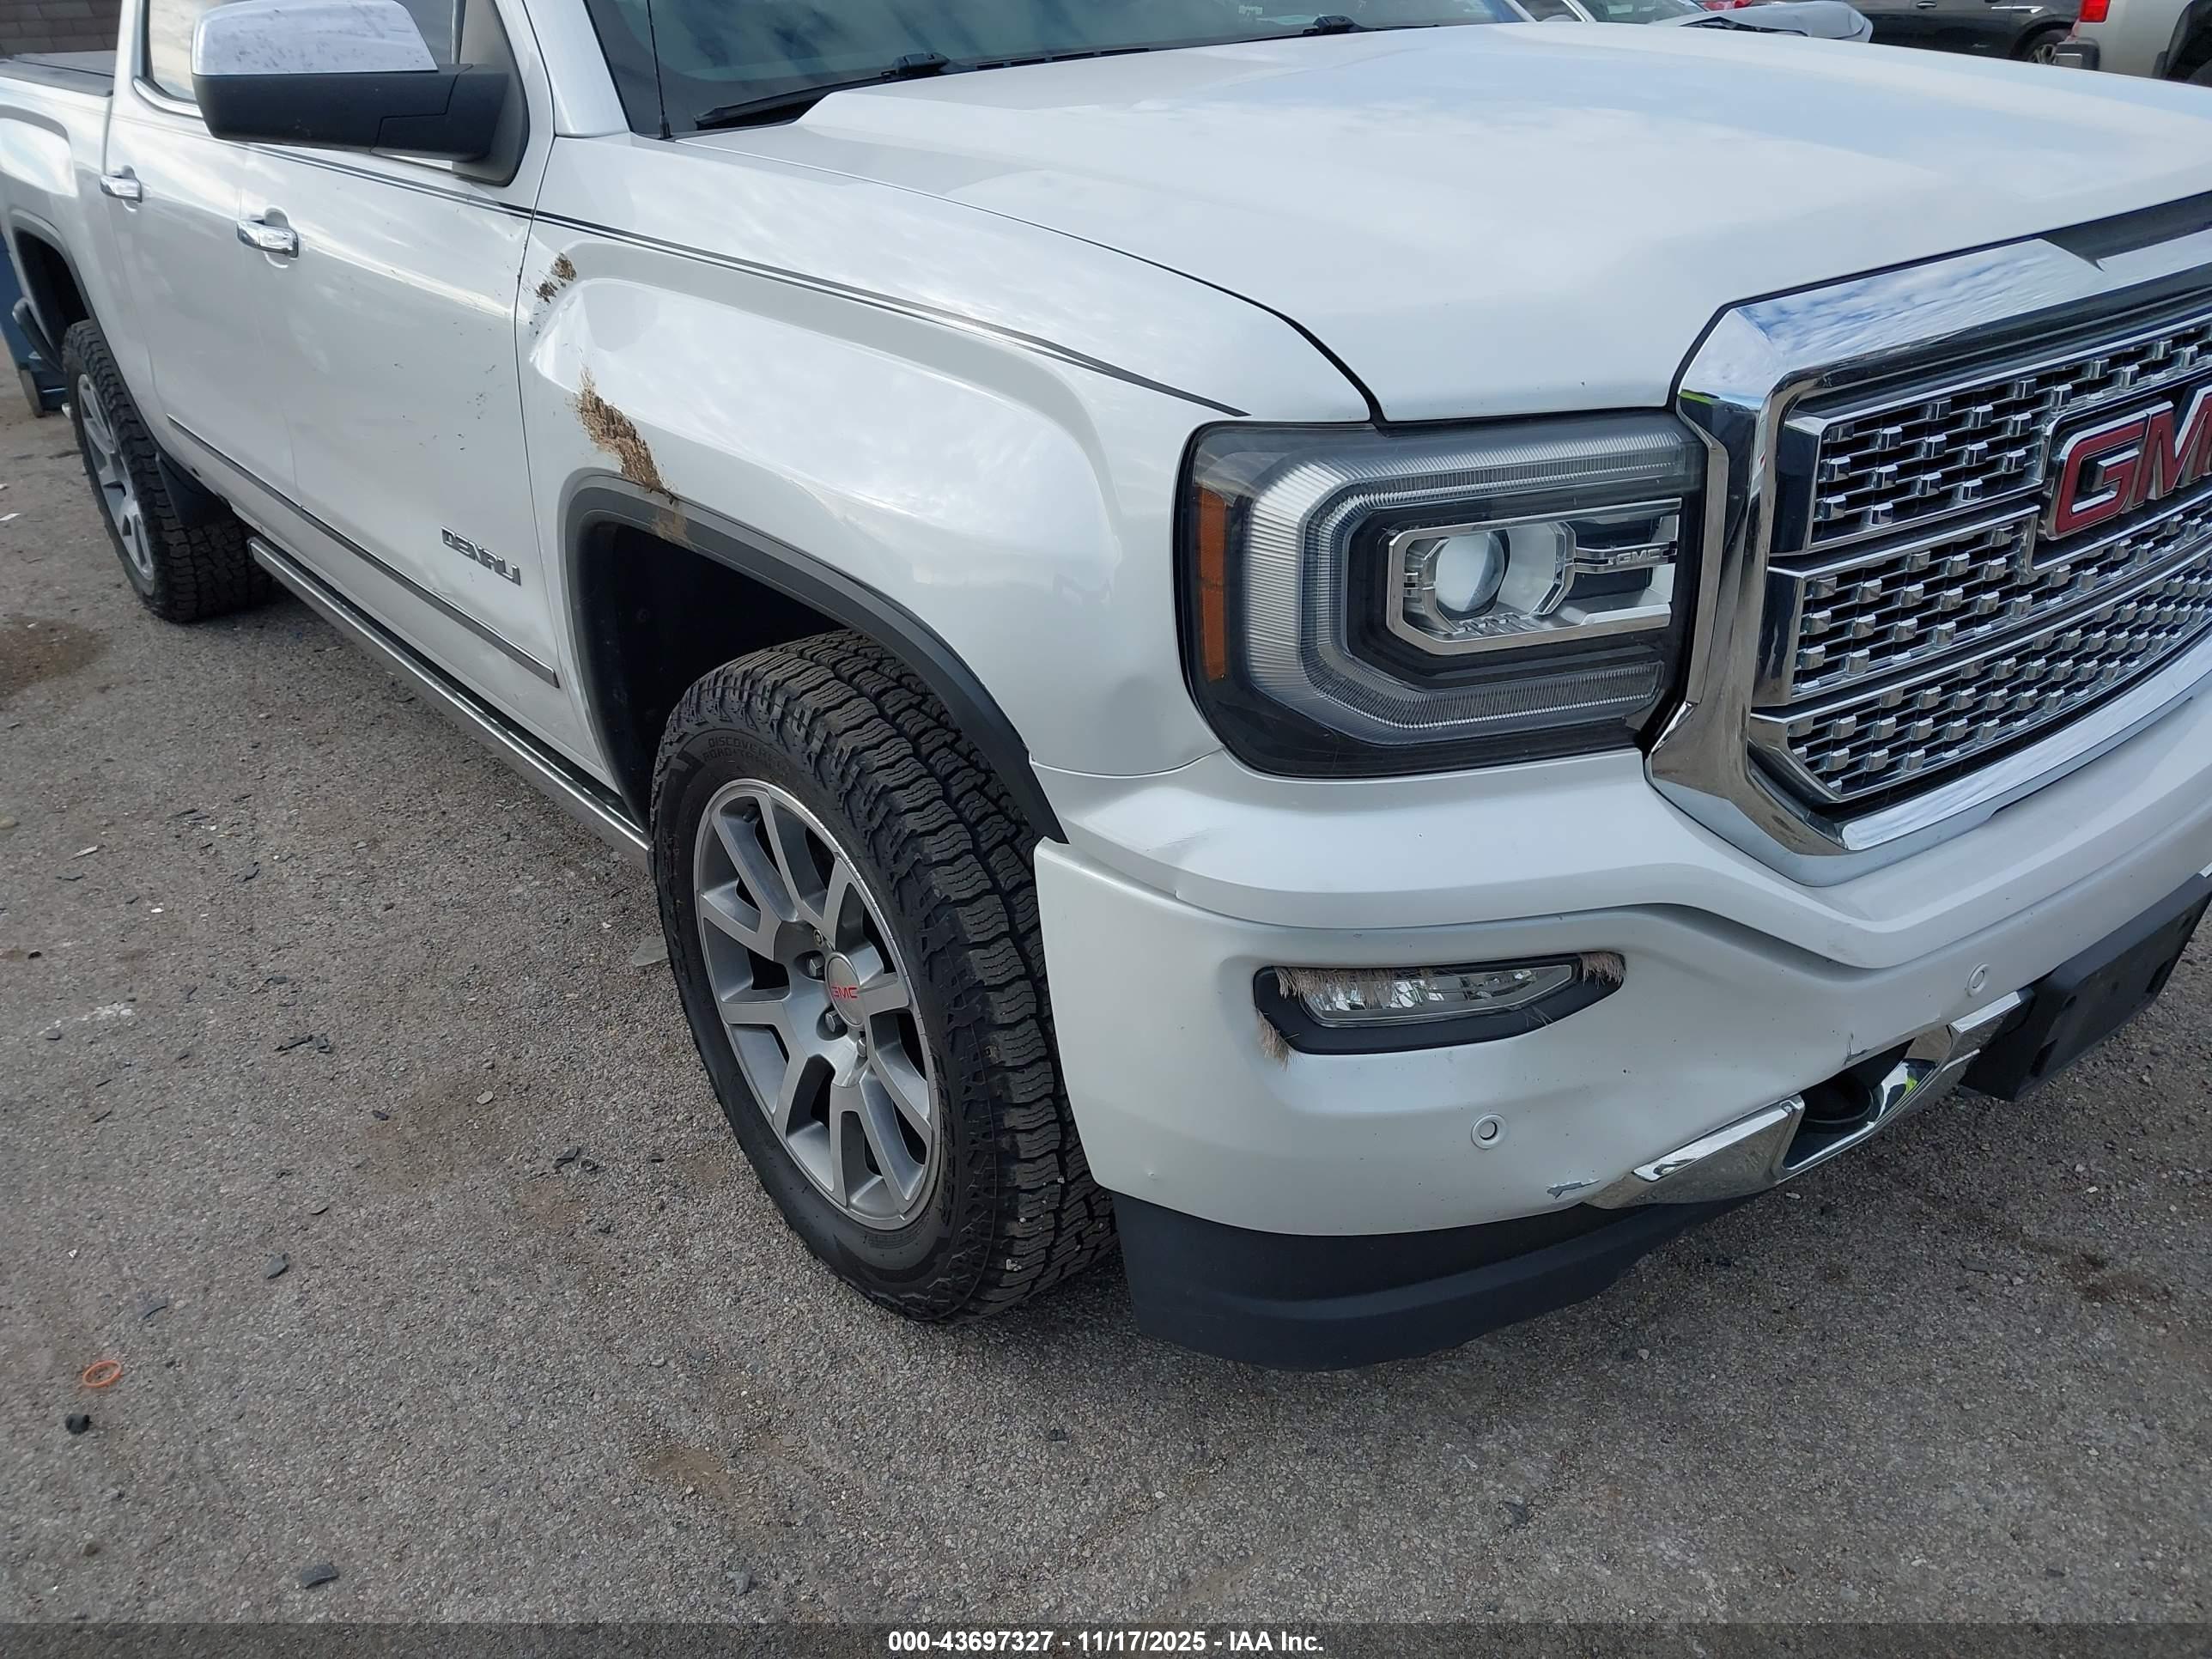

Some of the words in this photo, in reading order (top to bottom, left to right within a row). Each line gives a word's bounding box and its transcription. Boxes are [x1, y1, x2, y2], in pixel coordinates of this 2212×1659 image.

[2046, 386, 2212, 540] GM
[441, 526, 521, 586] DENALI
[1616, 548, 1661, 565] GMC
[830, 986, 858, 999] GMC
